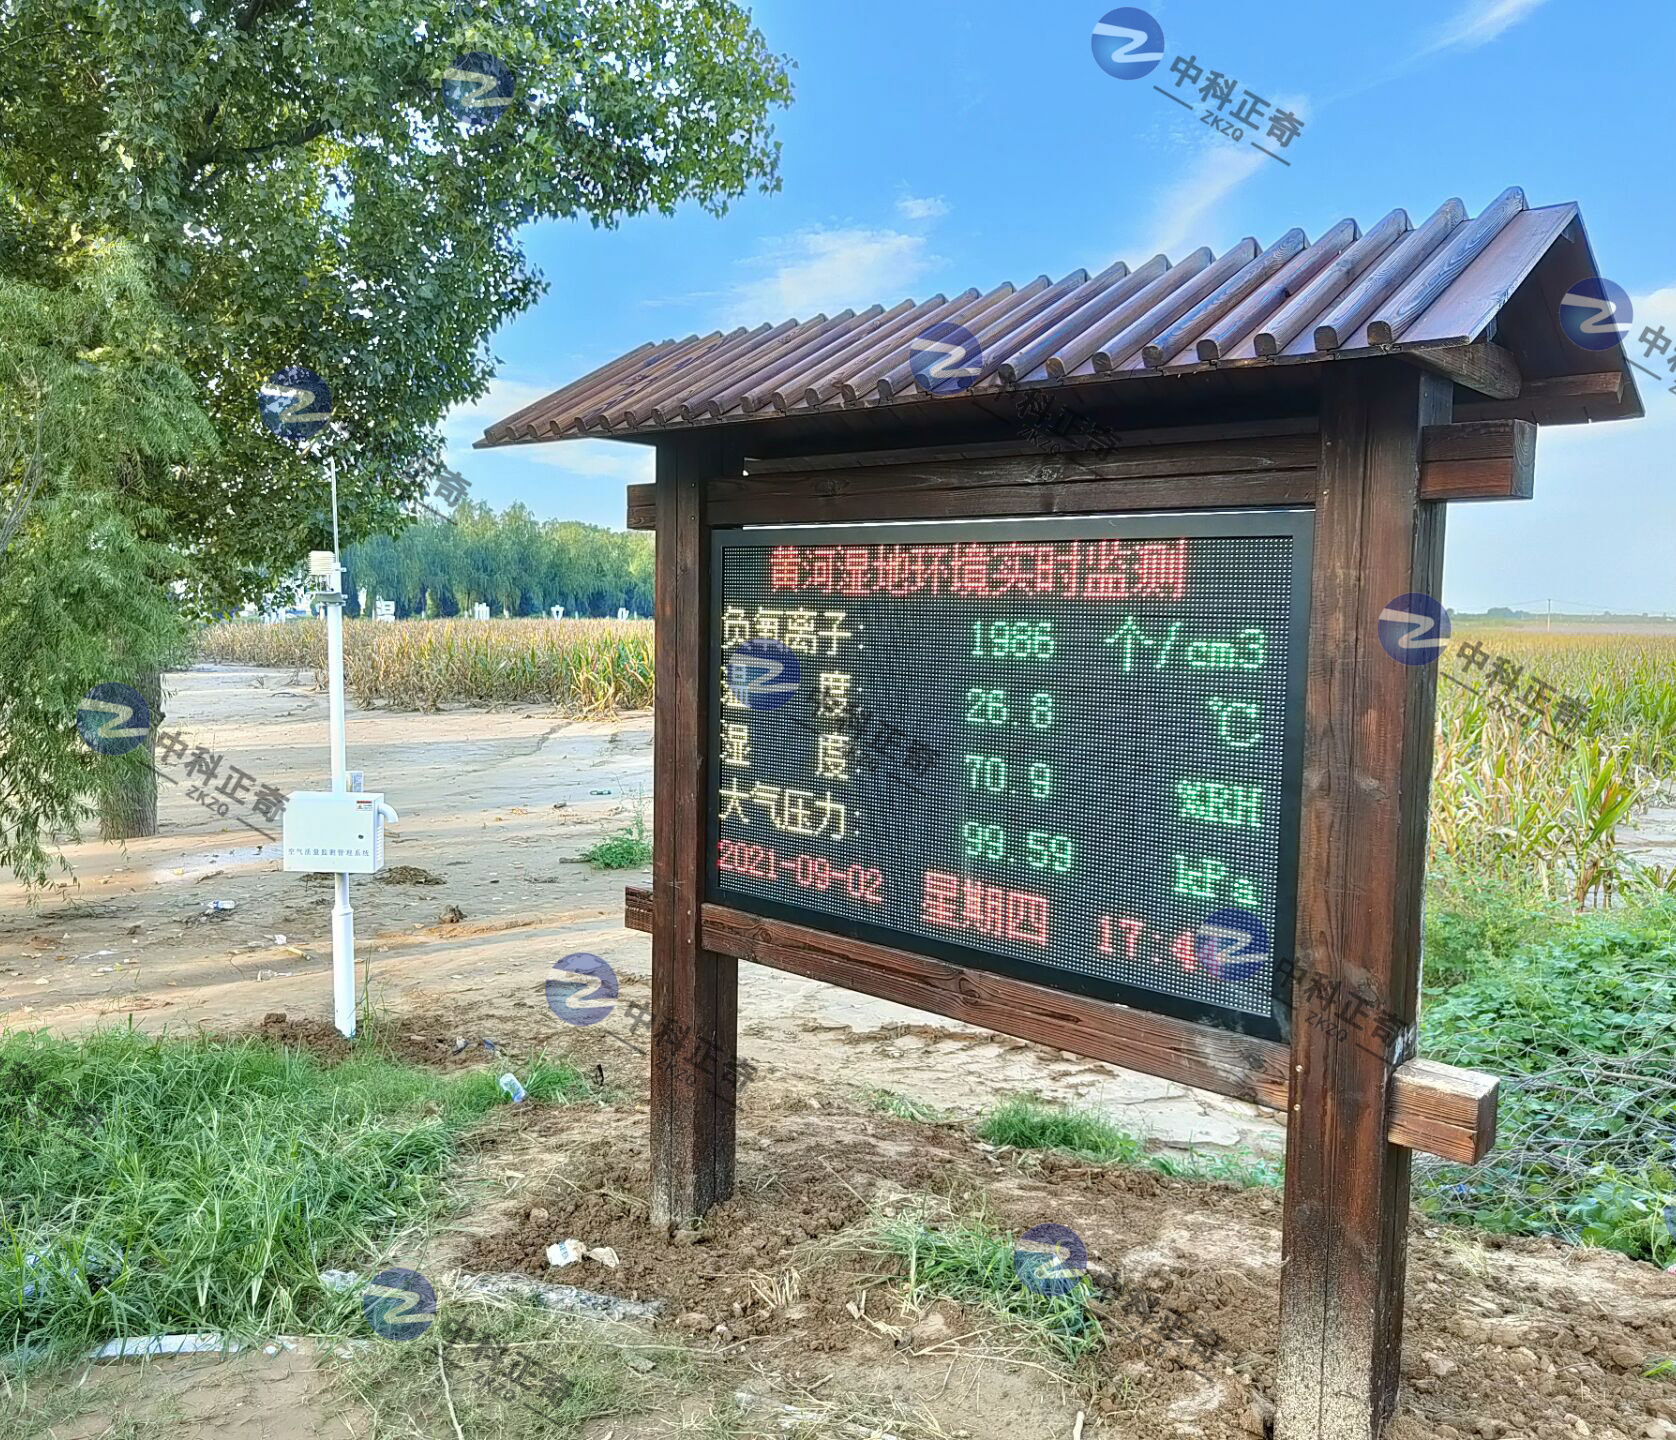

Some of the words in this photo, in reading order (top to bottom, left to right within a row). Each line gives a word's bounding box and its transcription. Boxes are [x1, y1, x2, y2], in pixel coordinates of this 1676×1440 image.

[770, 541, 1187, 601] 黄河湿地环境实时监测
[972, 621, 1055, 658] 1986
[1104, 616, 1267, 672] 个/cm3
[964, 688, 1054, 729] 26.8
[720, 718, 751, 765] 湿
[964, 754, 1052, 798] 70.9
[1177, 779, 1263, 828] %RH
[717, 839, 884, 904] 2021-09-02
[921, 869, 1050, 946] 星期四
[963, 821, 1073, 872] 99.59
[1172, 854, 1260, 906] kPa
